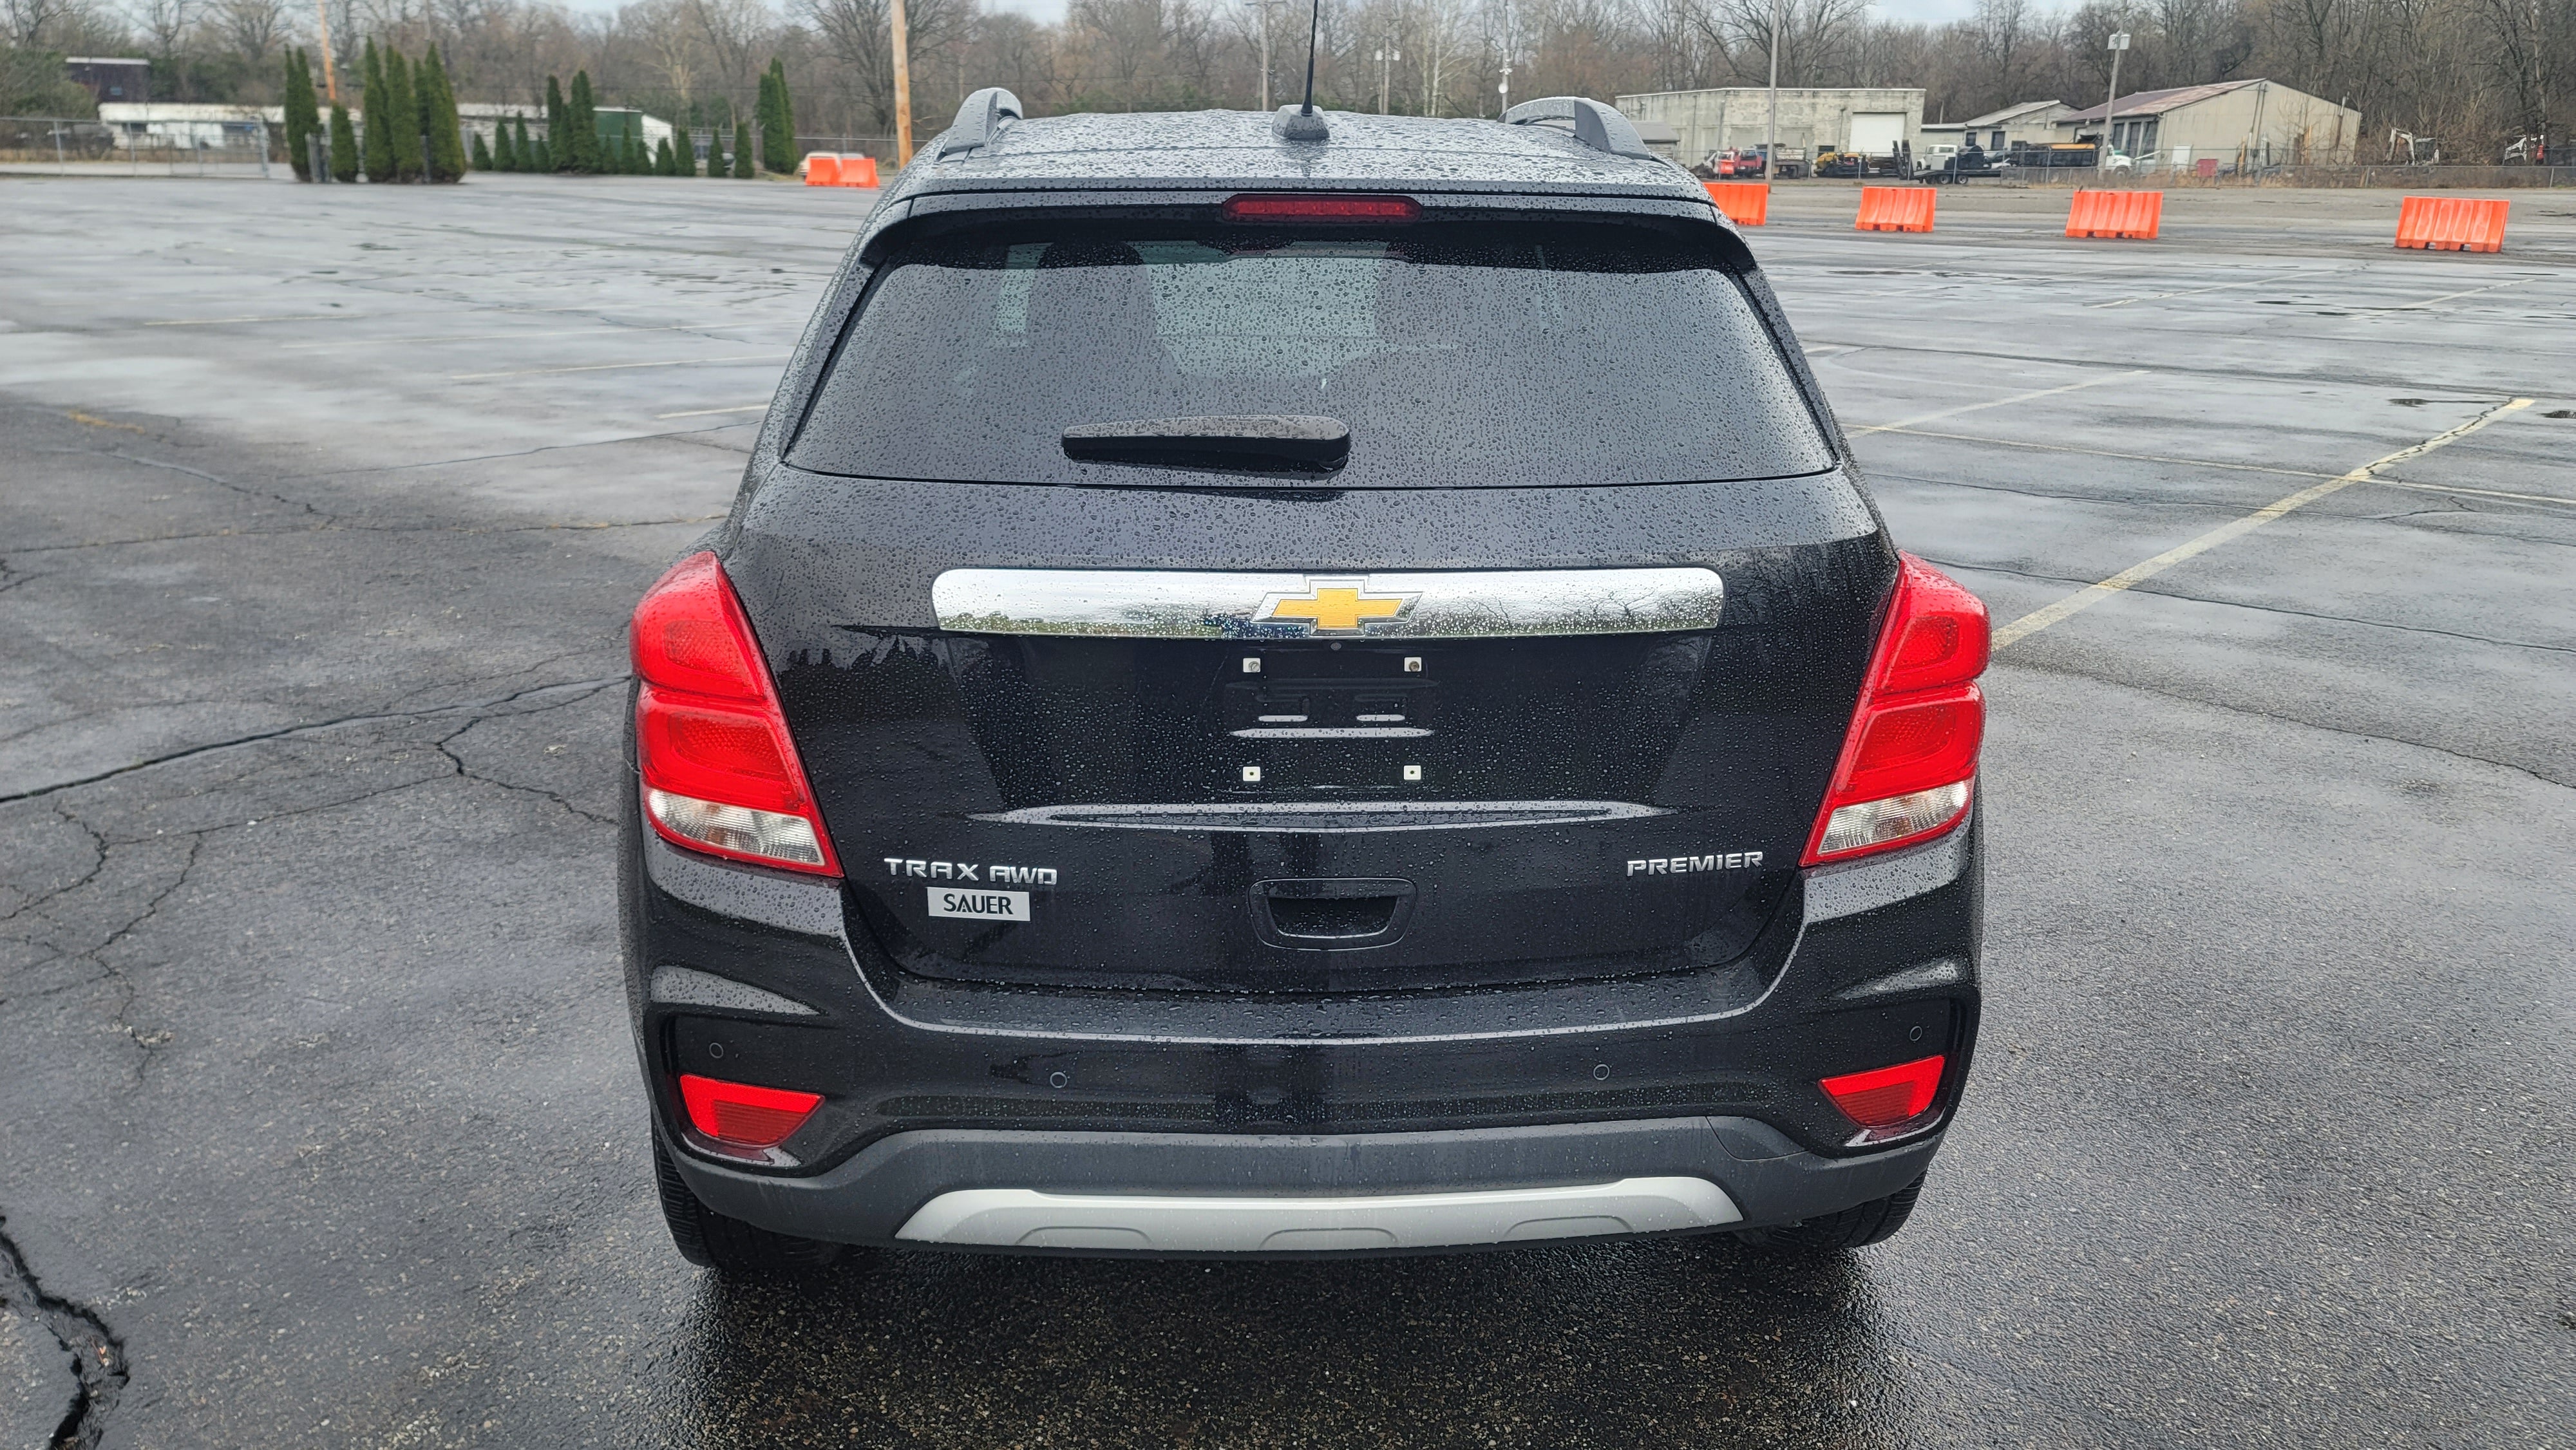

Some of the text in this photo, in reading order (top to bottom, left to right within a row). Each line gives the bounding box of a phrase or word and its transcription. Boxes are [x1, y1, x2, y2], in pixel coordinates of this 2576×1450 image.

[884, 858, 1057, 885] TRAX AWD
[1627, 851, 1763, 876] PREMIER
[943, 893, 1013, 915] SAUER
